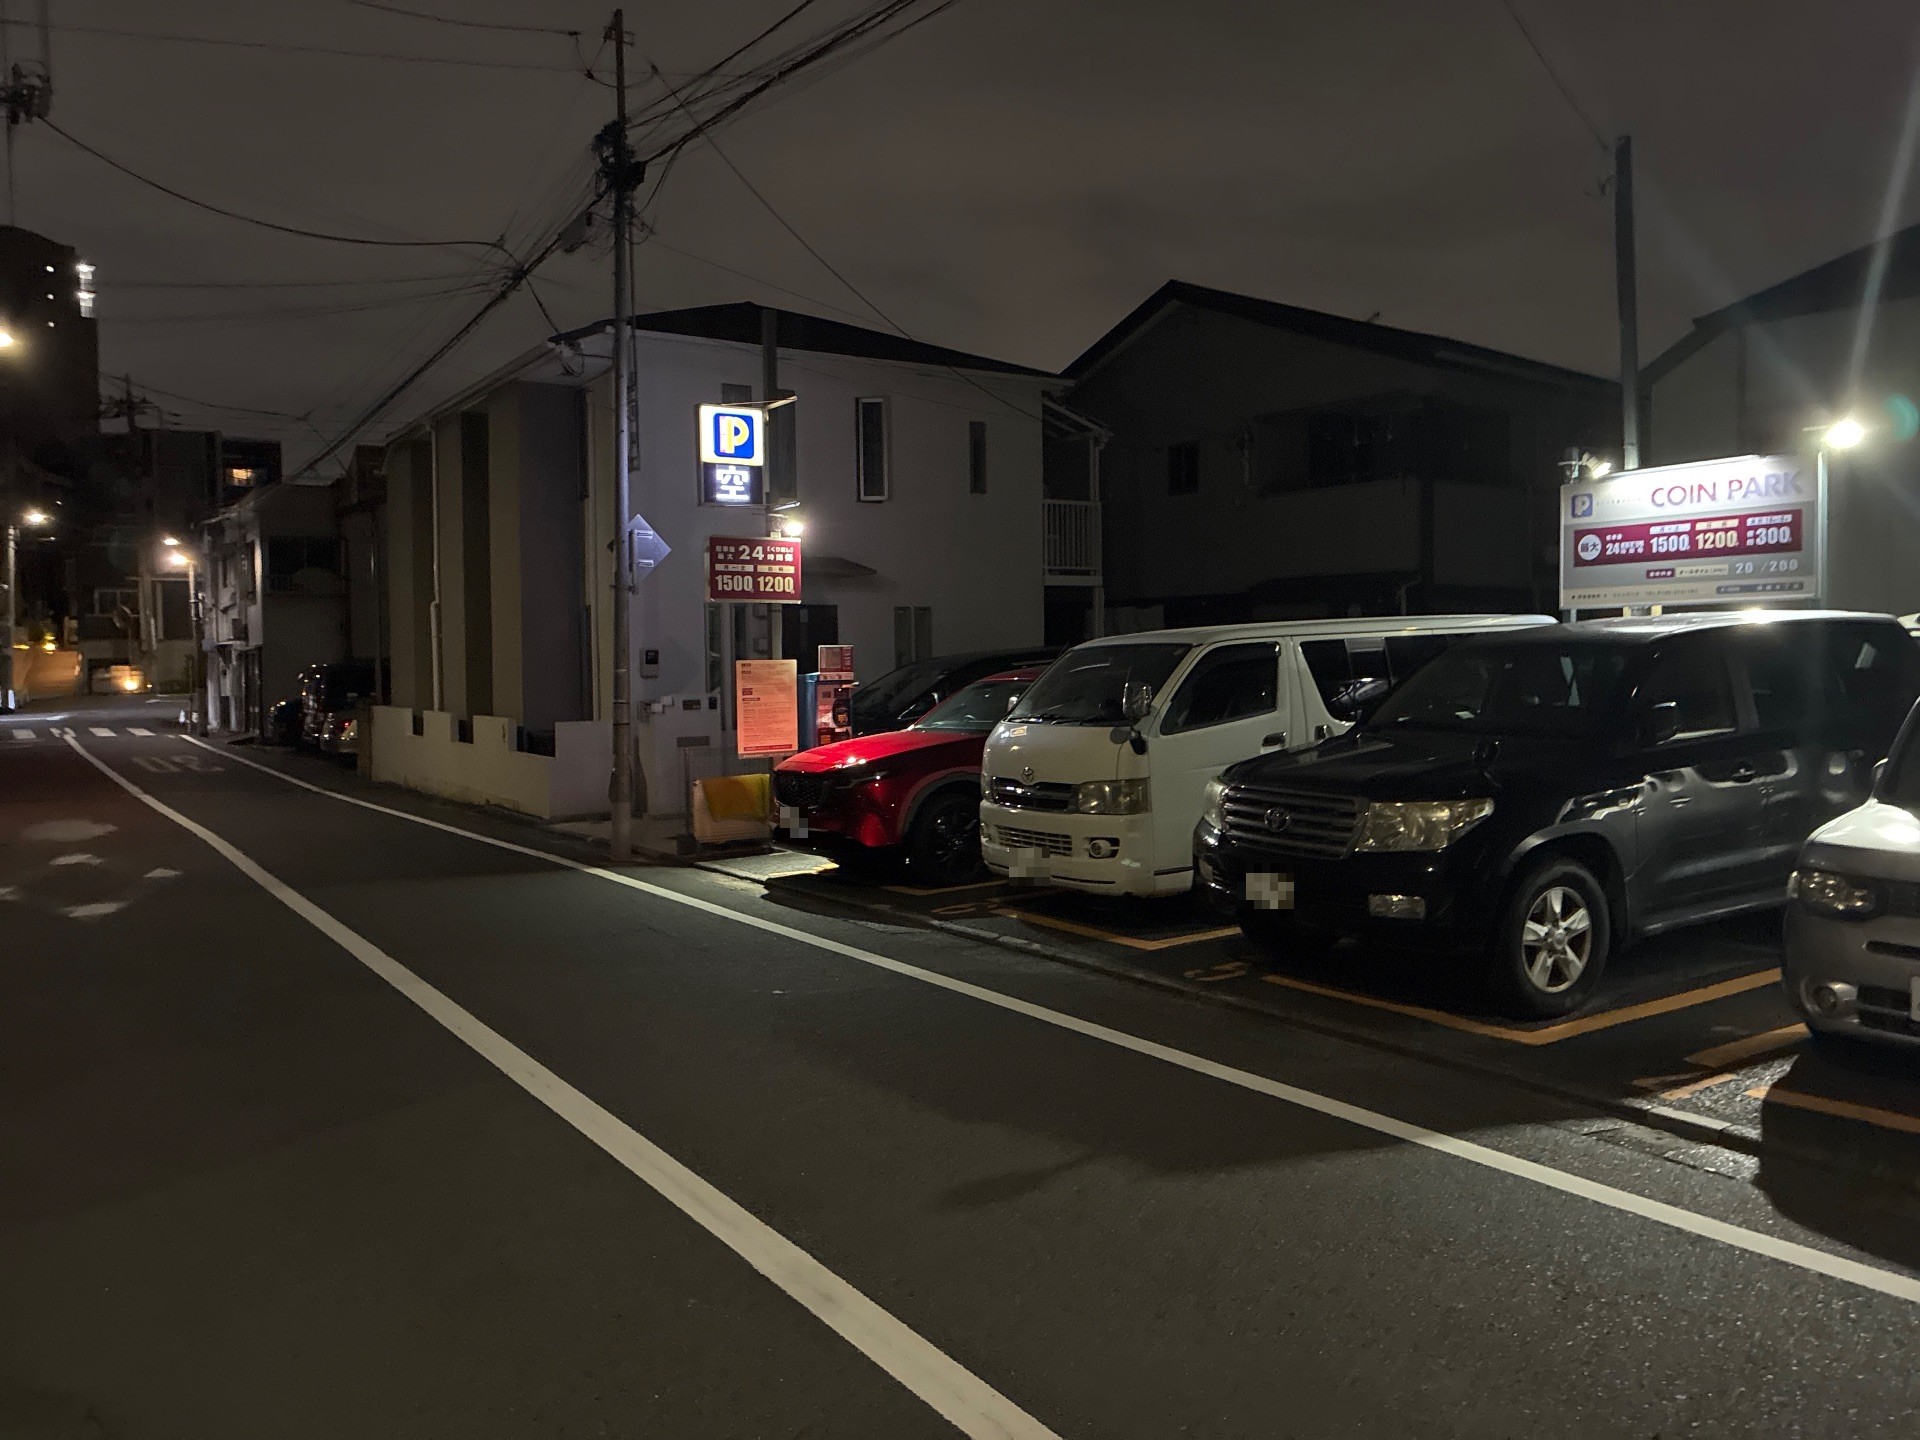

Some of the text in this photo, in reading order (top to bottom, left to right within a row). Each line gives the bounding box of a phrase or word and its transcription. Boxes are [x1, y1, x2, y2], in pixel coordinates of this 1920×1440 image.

[719, 415, 750, 454] P
[715, 465, 750, 502] 空
[1651, 472, 1805, 508] COIN PARK
[738, 545, 764, 561] 24
